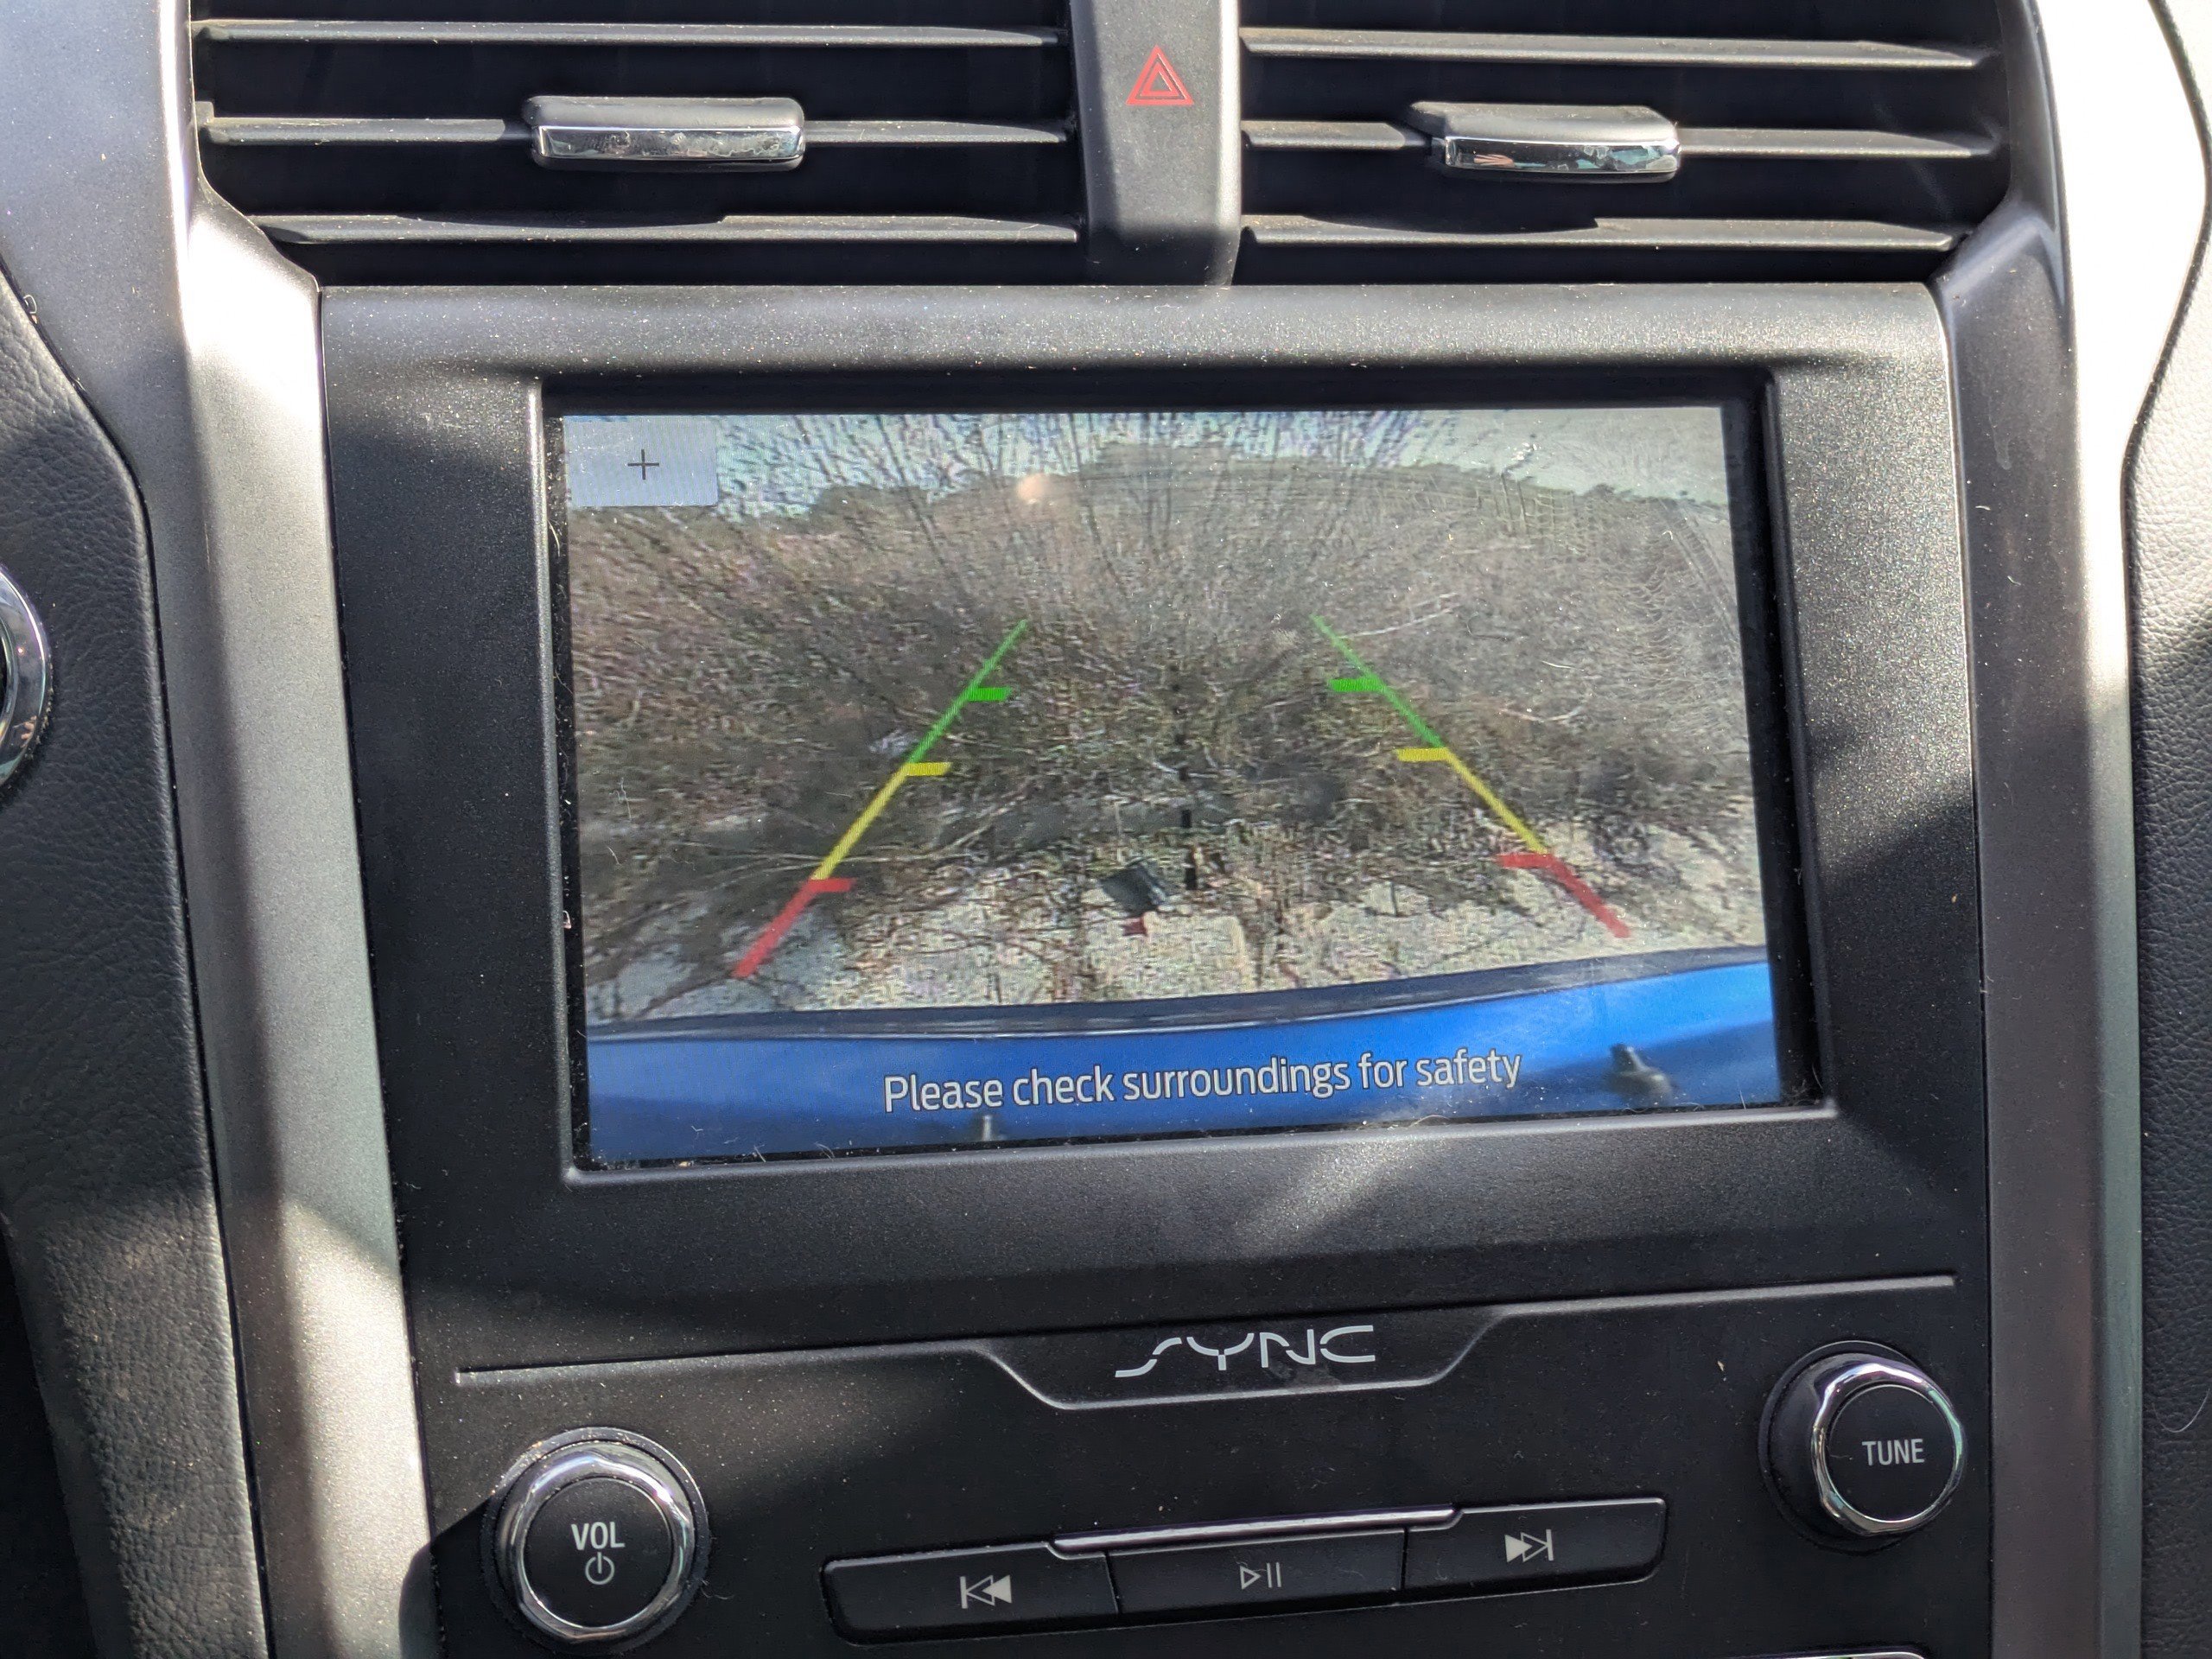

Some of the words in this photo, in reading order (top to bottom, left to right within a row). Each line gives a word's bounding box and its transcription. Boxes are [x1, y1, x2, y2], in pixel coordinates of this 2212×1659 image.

[884, 1073, 1003, 1113] Please
[1013, 1064, 1116, 1107] check
[1122, 1056, 1351, 1100] surroundings
[1357, 1050, 1408, 1090] for
[1414, 1047, 1522, 1089] safety
[1115, 1325, 1376, 1378] SYNC
[1861, 1438, 1926, 1466] TUNE
[570, 1521, 626, 1551] VOL
